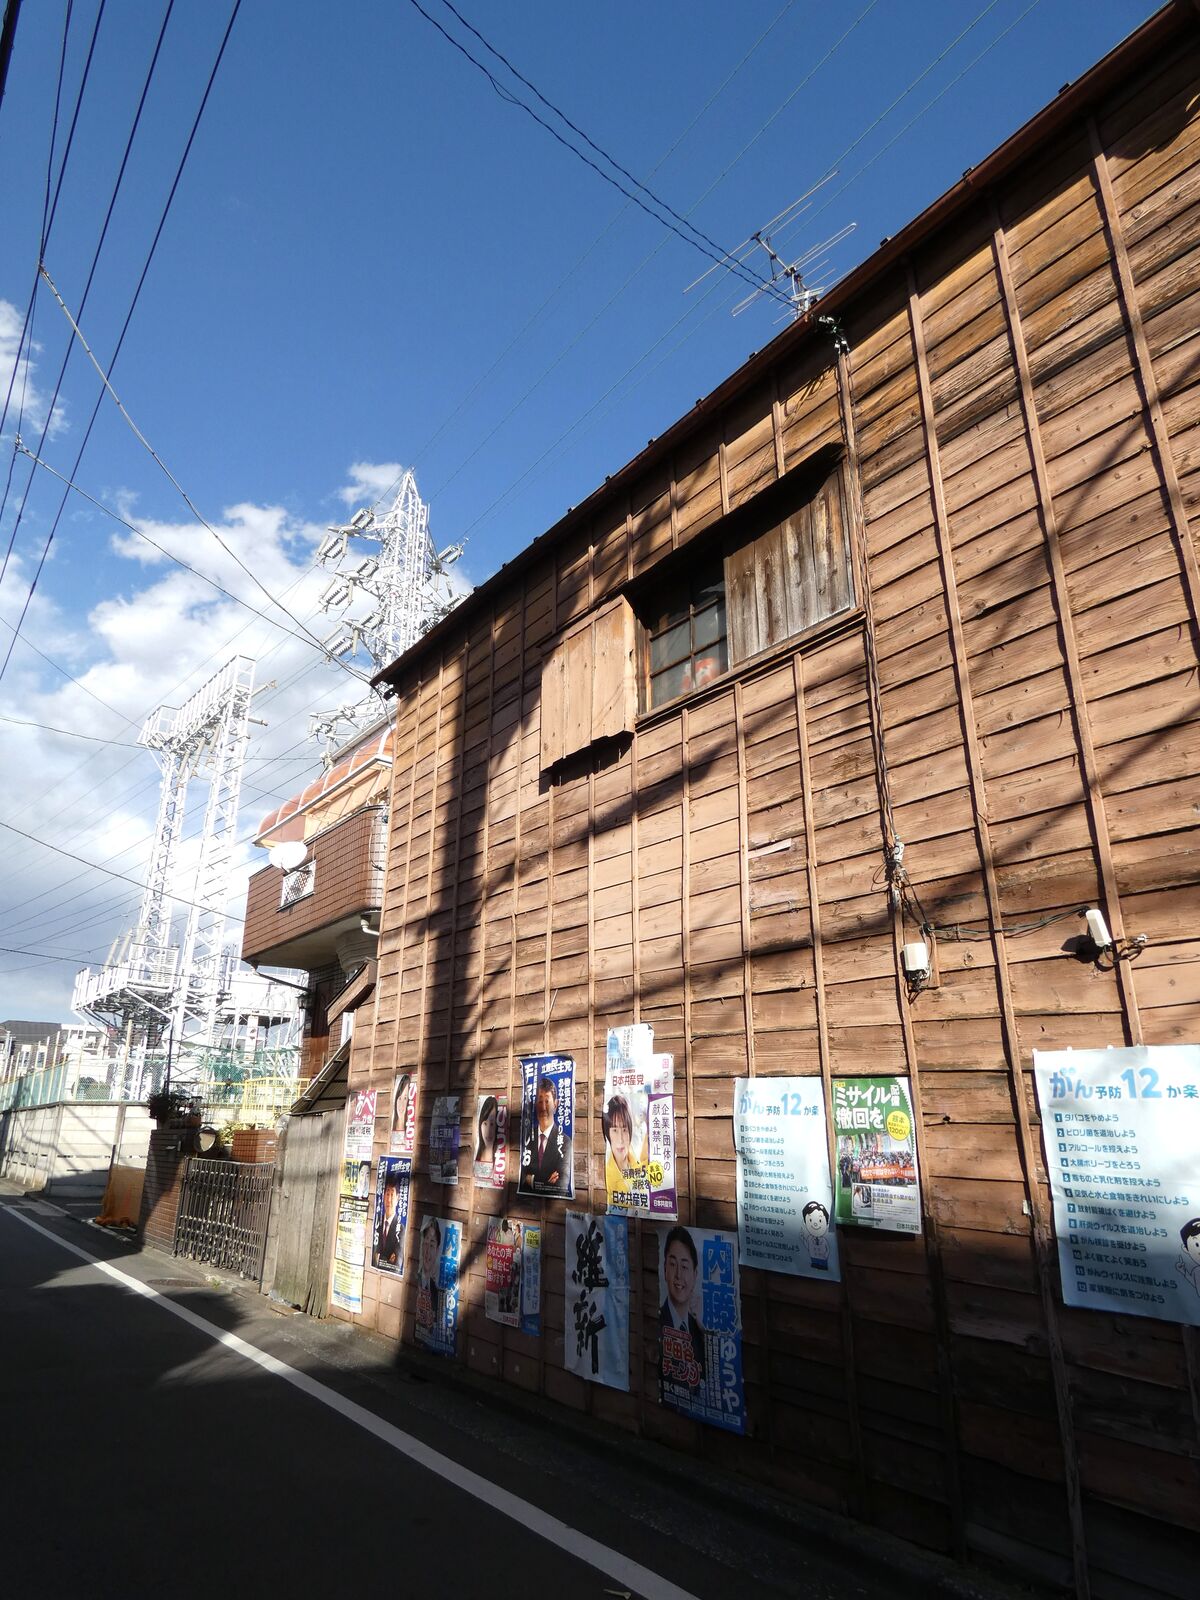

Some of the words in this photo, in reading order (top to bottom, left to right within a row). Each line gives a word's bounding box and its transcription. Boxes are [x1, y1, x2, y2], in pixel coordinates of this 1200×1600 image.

[541, 1059, 572, 1074] 立憲民主党
[612, 1074, 644, 1087] 日本共産党
[740, 1090, 819, 1116] がん予防12か条
[836, 1085, 891, 1107] ミサイル
[836, 1106, 884, 1130] 撤回を
[1064, 1113, 1119, 1122] タバコをやめよう
[494, 1105, 507, 1172] ひうち
[651, 1104, 662, 1157] 献金禁止
[660, 1102, 672, 1172] 企業・団体の
[1068, 1143, 1138, 1154] アルコールを控えよう
[650, 1172, 662, 1183] NO
[1072, 1173, 1161, 1187] ものと乳化剤を控えよう
[613, 1191, 648, 1207] 日本共産党
[654, 1200, 673, 1208] 日本共産党
[1078, 1204, 1157, 1220] 放射被ばくを避けよう
[896, 1222, 919, 1232] 日本共産党
[487, 1245, 513, 1260] あなたの声
[571, 1220, 609, 1375] 維新
[446, 1294, 456, 1345] ゆうや
[721, 1337, 741, 1412] ゆうや
